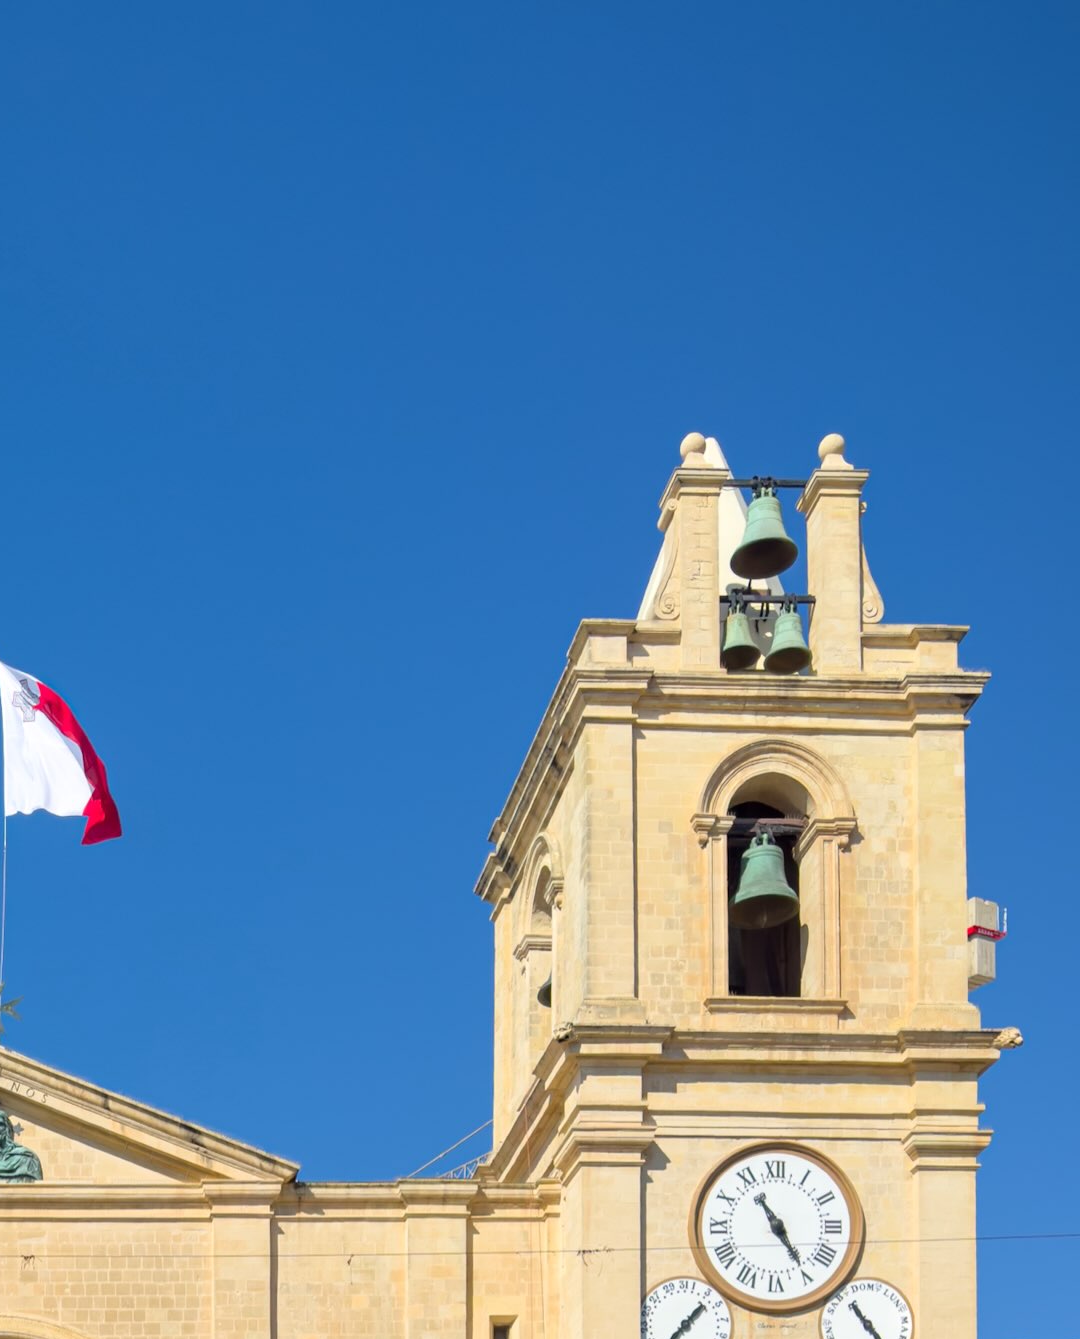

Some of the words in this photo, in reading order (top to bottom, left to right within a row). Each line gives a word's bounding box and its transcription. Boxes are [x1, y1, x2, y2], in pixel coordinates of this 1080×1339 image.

[11, 1082, 48, 1104] NOS
[736, 1166, 757, 1188] XI
[765, 1161, 786, 1179] XII
[800, 1169, 812, 1186] I
[717, 1189, 736, 1207] X
[816, 1190, 836, 1207] II
[710, 1217, 728, 1235] IX
[824, 1219, 842, 1234] III
[714, 1242, 738, 1270] VIII
[813, 1243, 837, 1268] IIII
[679, 1280, 688, 1289] 31
[736, 1264, 757, 1289] VII
[768, 1274, 784, 1293] VI
[800, 1269, 814, 1286] V
[662, 1283, 675, 1293] 29
[704, 1288, 712, 1297] 3
[649, 1291, 660, 1304] 27
[715, 1300, 723, 1308] 5
